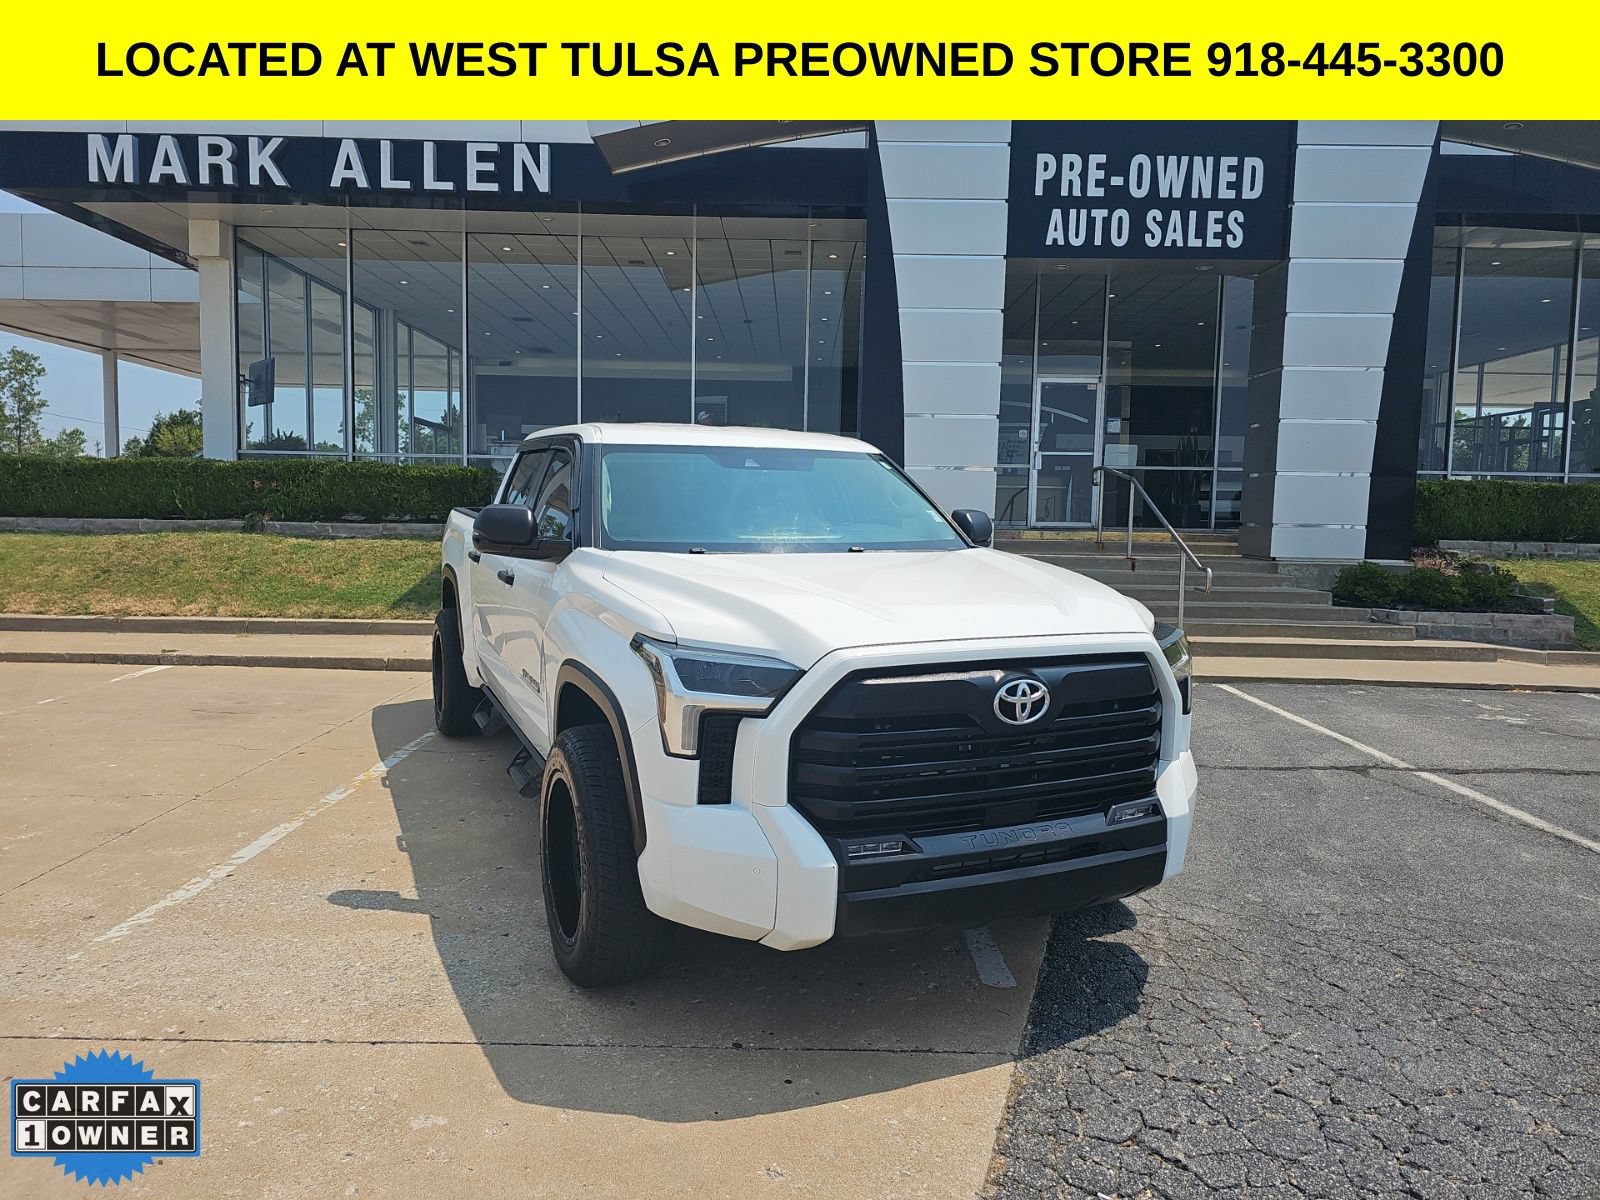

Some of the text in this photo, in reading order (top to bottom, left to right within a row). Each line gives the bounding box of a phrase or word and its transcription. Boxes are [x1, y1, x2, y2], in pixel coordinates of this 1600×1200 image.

[87, 133, 552, 194] MARK ALLEN
[1034, 152, 1264, 200] PRE-OWNED
[1045, 208, 1245, 249] AUTO SALES
[959, 821, 1075, 850] TUNDRA
